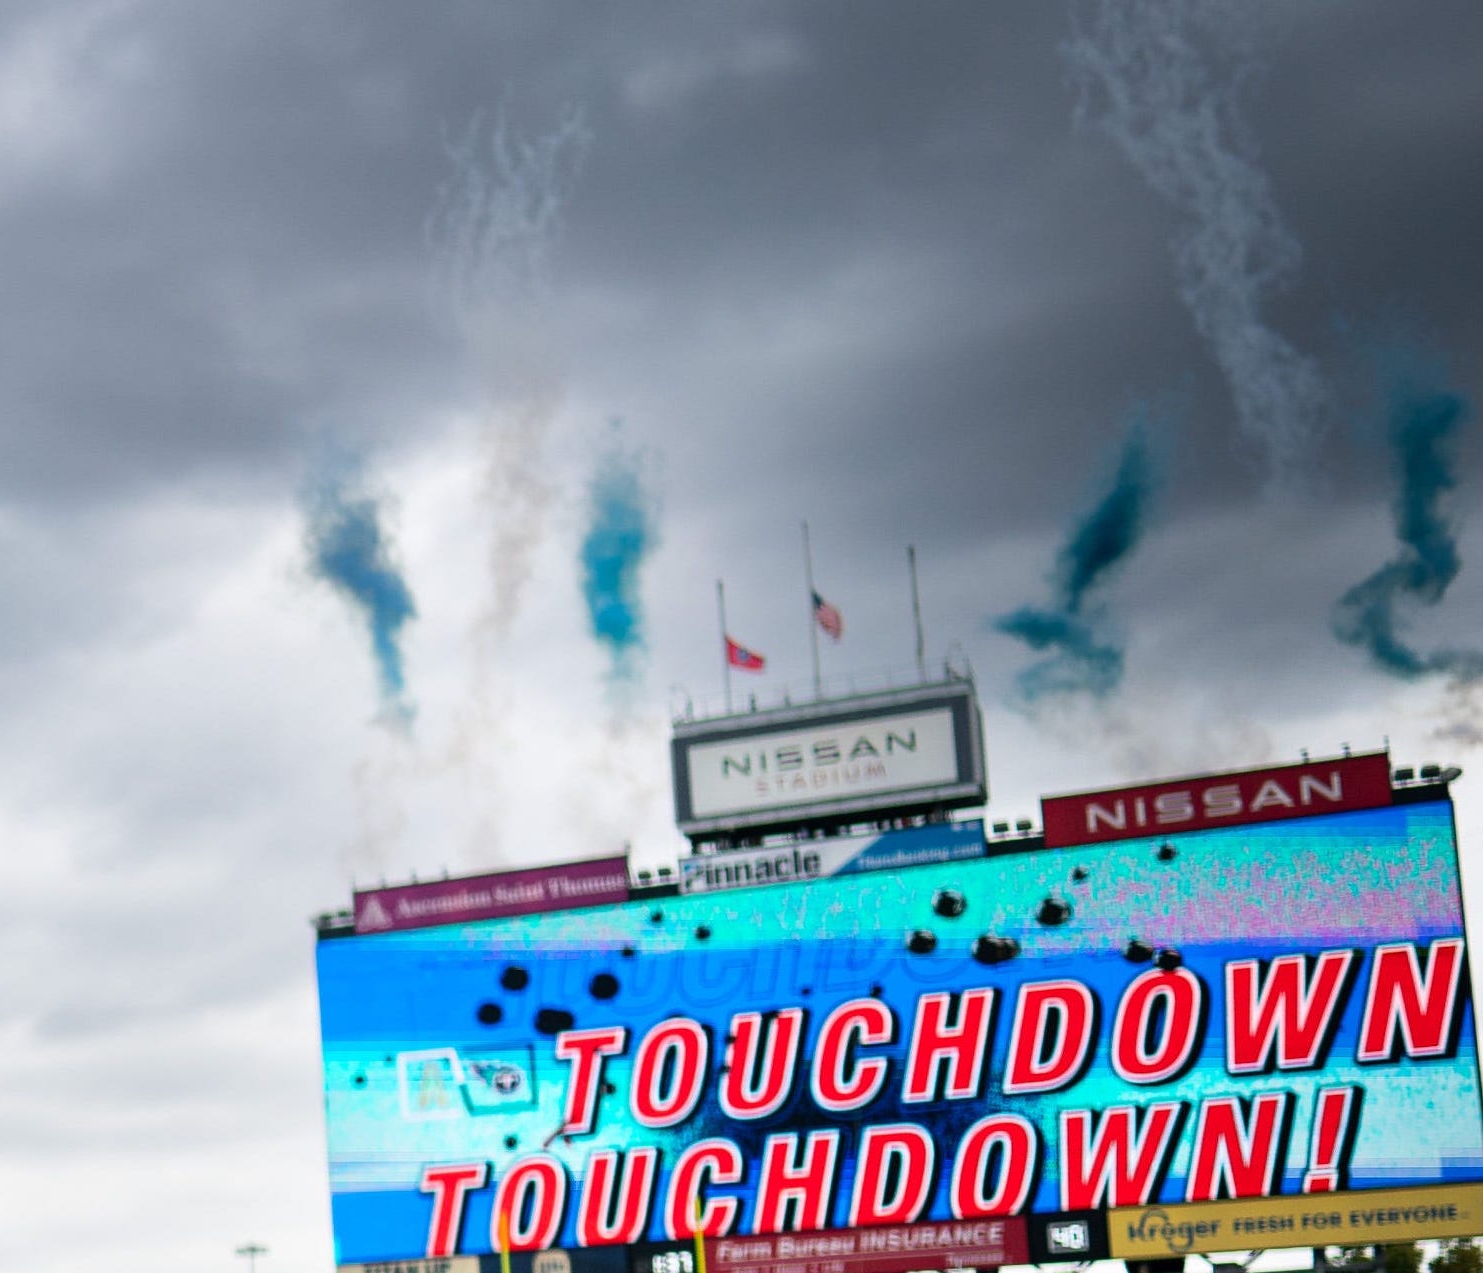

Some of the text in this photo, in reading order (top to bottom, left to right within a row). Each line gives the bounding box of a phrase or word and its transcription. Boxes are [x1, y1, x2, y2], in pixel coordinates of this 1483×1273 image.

[723, 728, 917, 778] NISSAN
[756, 763, 886, 796] STADIUM
[1085, 772, 1343, 833] NISSAN
[683, 847, 822, 890] Pinnacle
[555, 939, 1465, 1135] TOUCHDOWN
[420, 1086, 1353, 1258] TOUCHDOWN!
[715, 1239, 772, 1263] Farm
[859, 1221, 1005, 1254] INSURANCE
[1127, 1208, 1222, 1252] Kroger
[1233, 1214, 1294, 1233] FRESH
[1301, 1211, 1342, 1231] FOR
